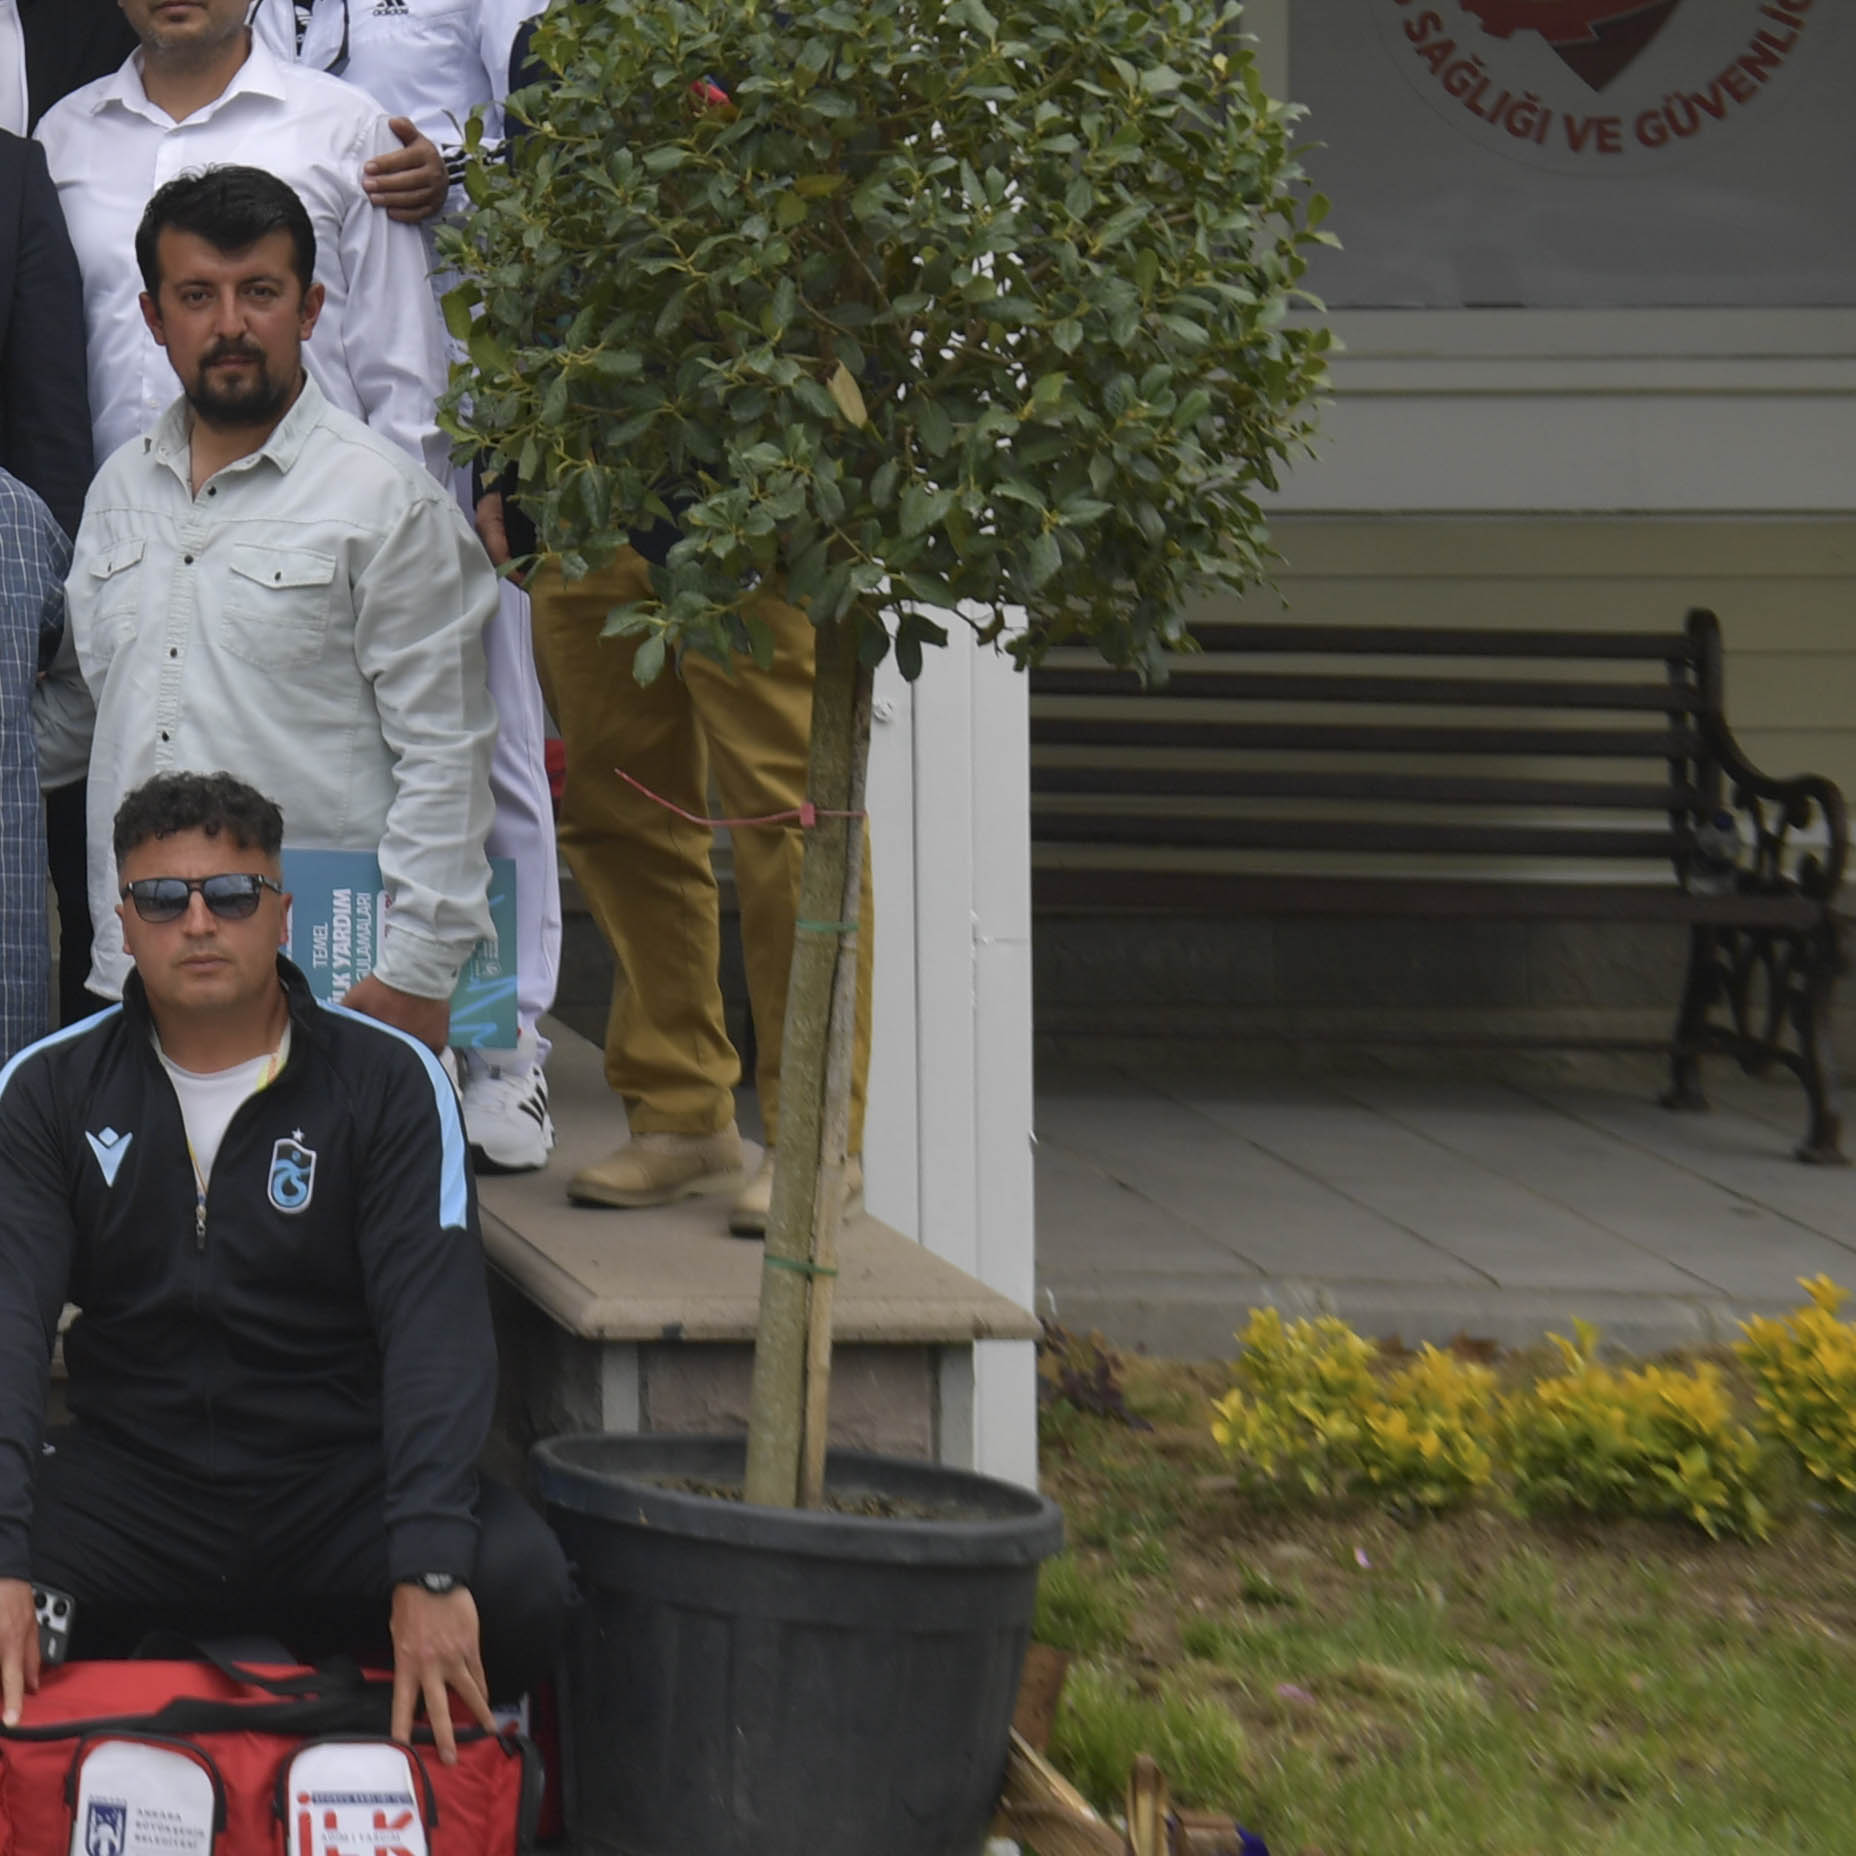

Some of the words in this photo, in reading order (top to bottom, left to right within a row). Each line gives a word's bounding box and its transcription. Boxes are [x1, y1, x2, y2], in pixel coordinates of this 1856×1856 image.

[1402, 9, 1553, 147] SAĞLIĞI
[1562, 112, 1624, 156] VE
[312, 922, 329, 969] TEMEL
[332, 888, 352, 969] YARDIM
